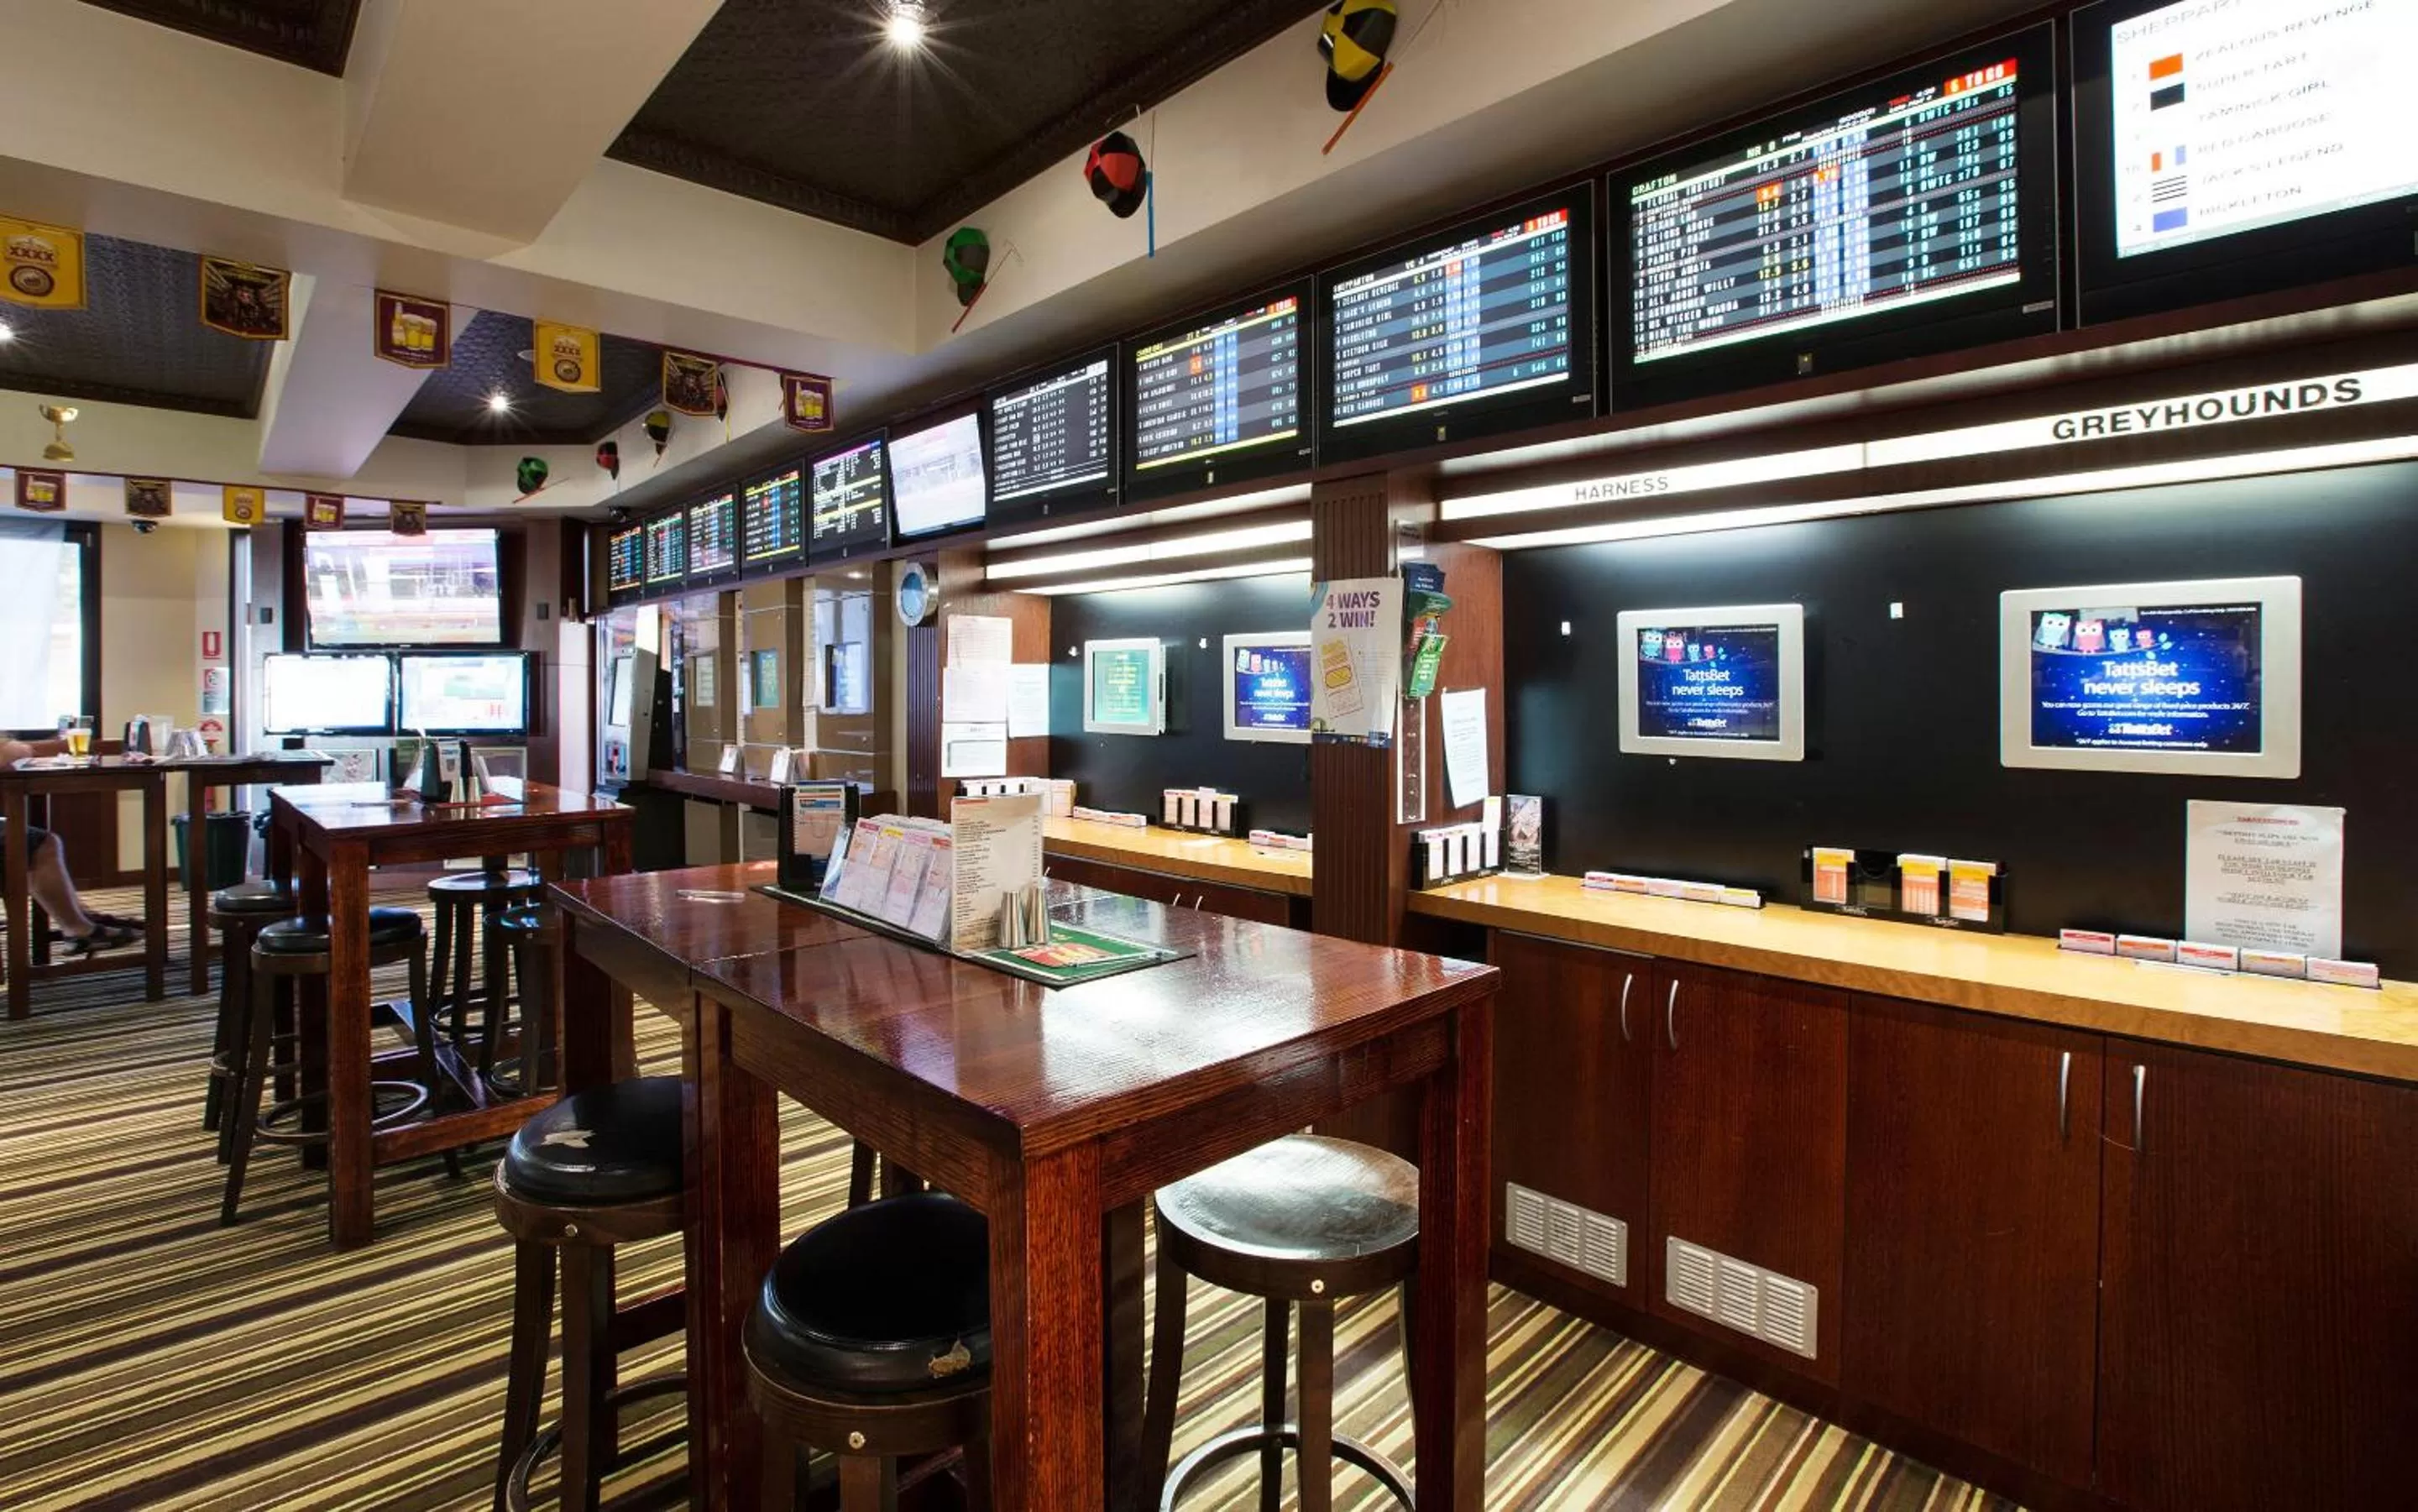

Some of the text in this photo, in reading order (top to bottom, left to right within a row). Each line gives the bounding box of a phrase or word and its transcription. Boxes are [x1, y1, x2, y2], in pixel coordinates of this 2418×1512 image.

[1632, 174, 1677, 196] GRAFTON
[9, 246, 55, 262] XXXX
[2053, 378, 2362, 440] GREYHOUNDS
[1575, 476, 1669, 500] HARNESS
[1326, 591, 1381, 610] 4 WAYS
[1328, 610, 1376, 628] 2 WIN!
[1683, 669, 1730, 683] TattsBet
[2101, 660, 2179, 677] TattsBet
[1672, 684, 1744, 698] never sleeps
[2084, 679, 2201, 698] never sleeps
